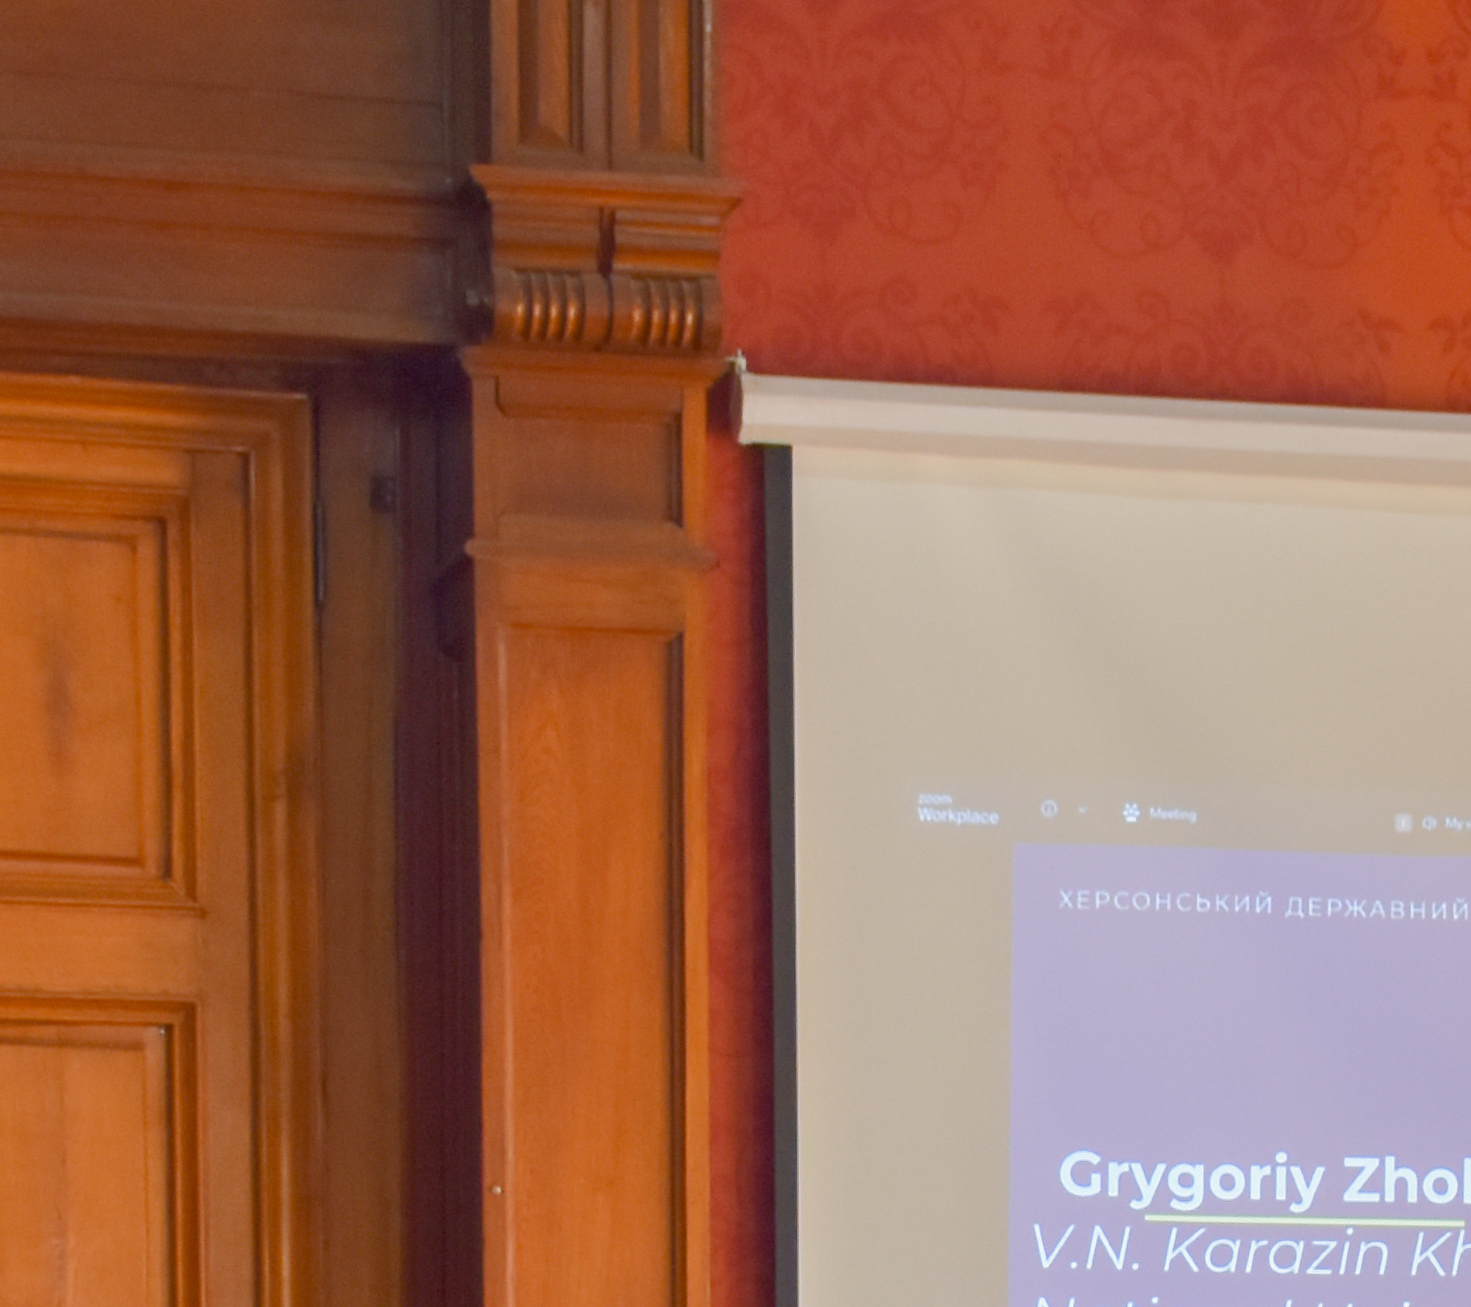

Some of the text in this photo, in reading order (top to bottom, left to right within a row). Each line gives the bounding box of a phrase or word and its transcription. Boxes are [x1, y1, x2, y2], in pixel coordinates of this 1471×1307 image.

[917, 806, 1000, 826] Workplace
[1148, 806, 1198, 824] Meeting
[1058, 888, 1273, 915] ХЕРСОНСЬКИЙ
[1284, 893, 1470, 921] ДЕРЖАВНИЙ
[1059, 1150, 1326, 1213] Grygoriy
[1032, 1222, 1140, 1271] V.N.
[1162, 1227, 1389, 1277] Karazin
